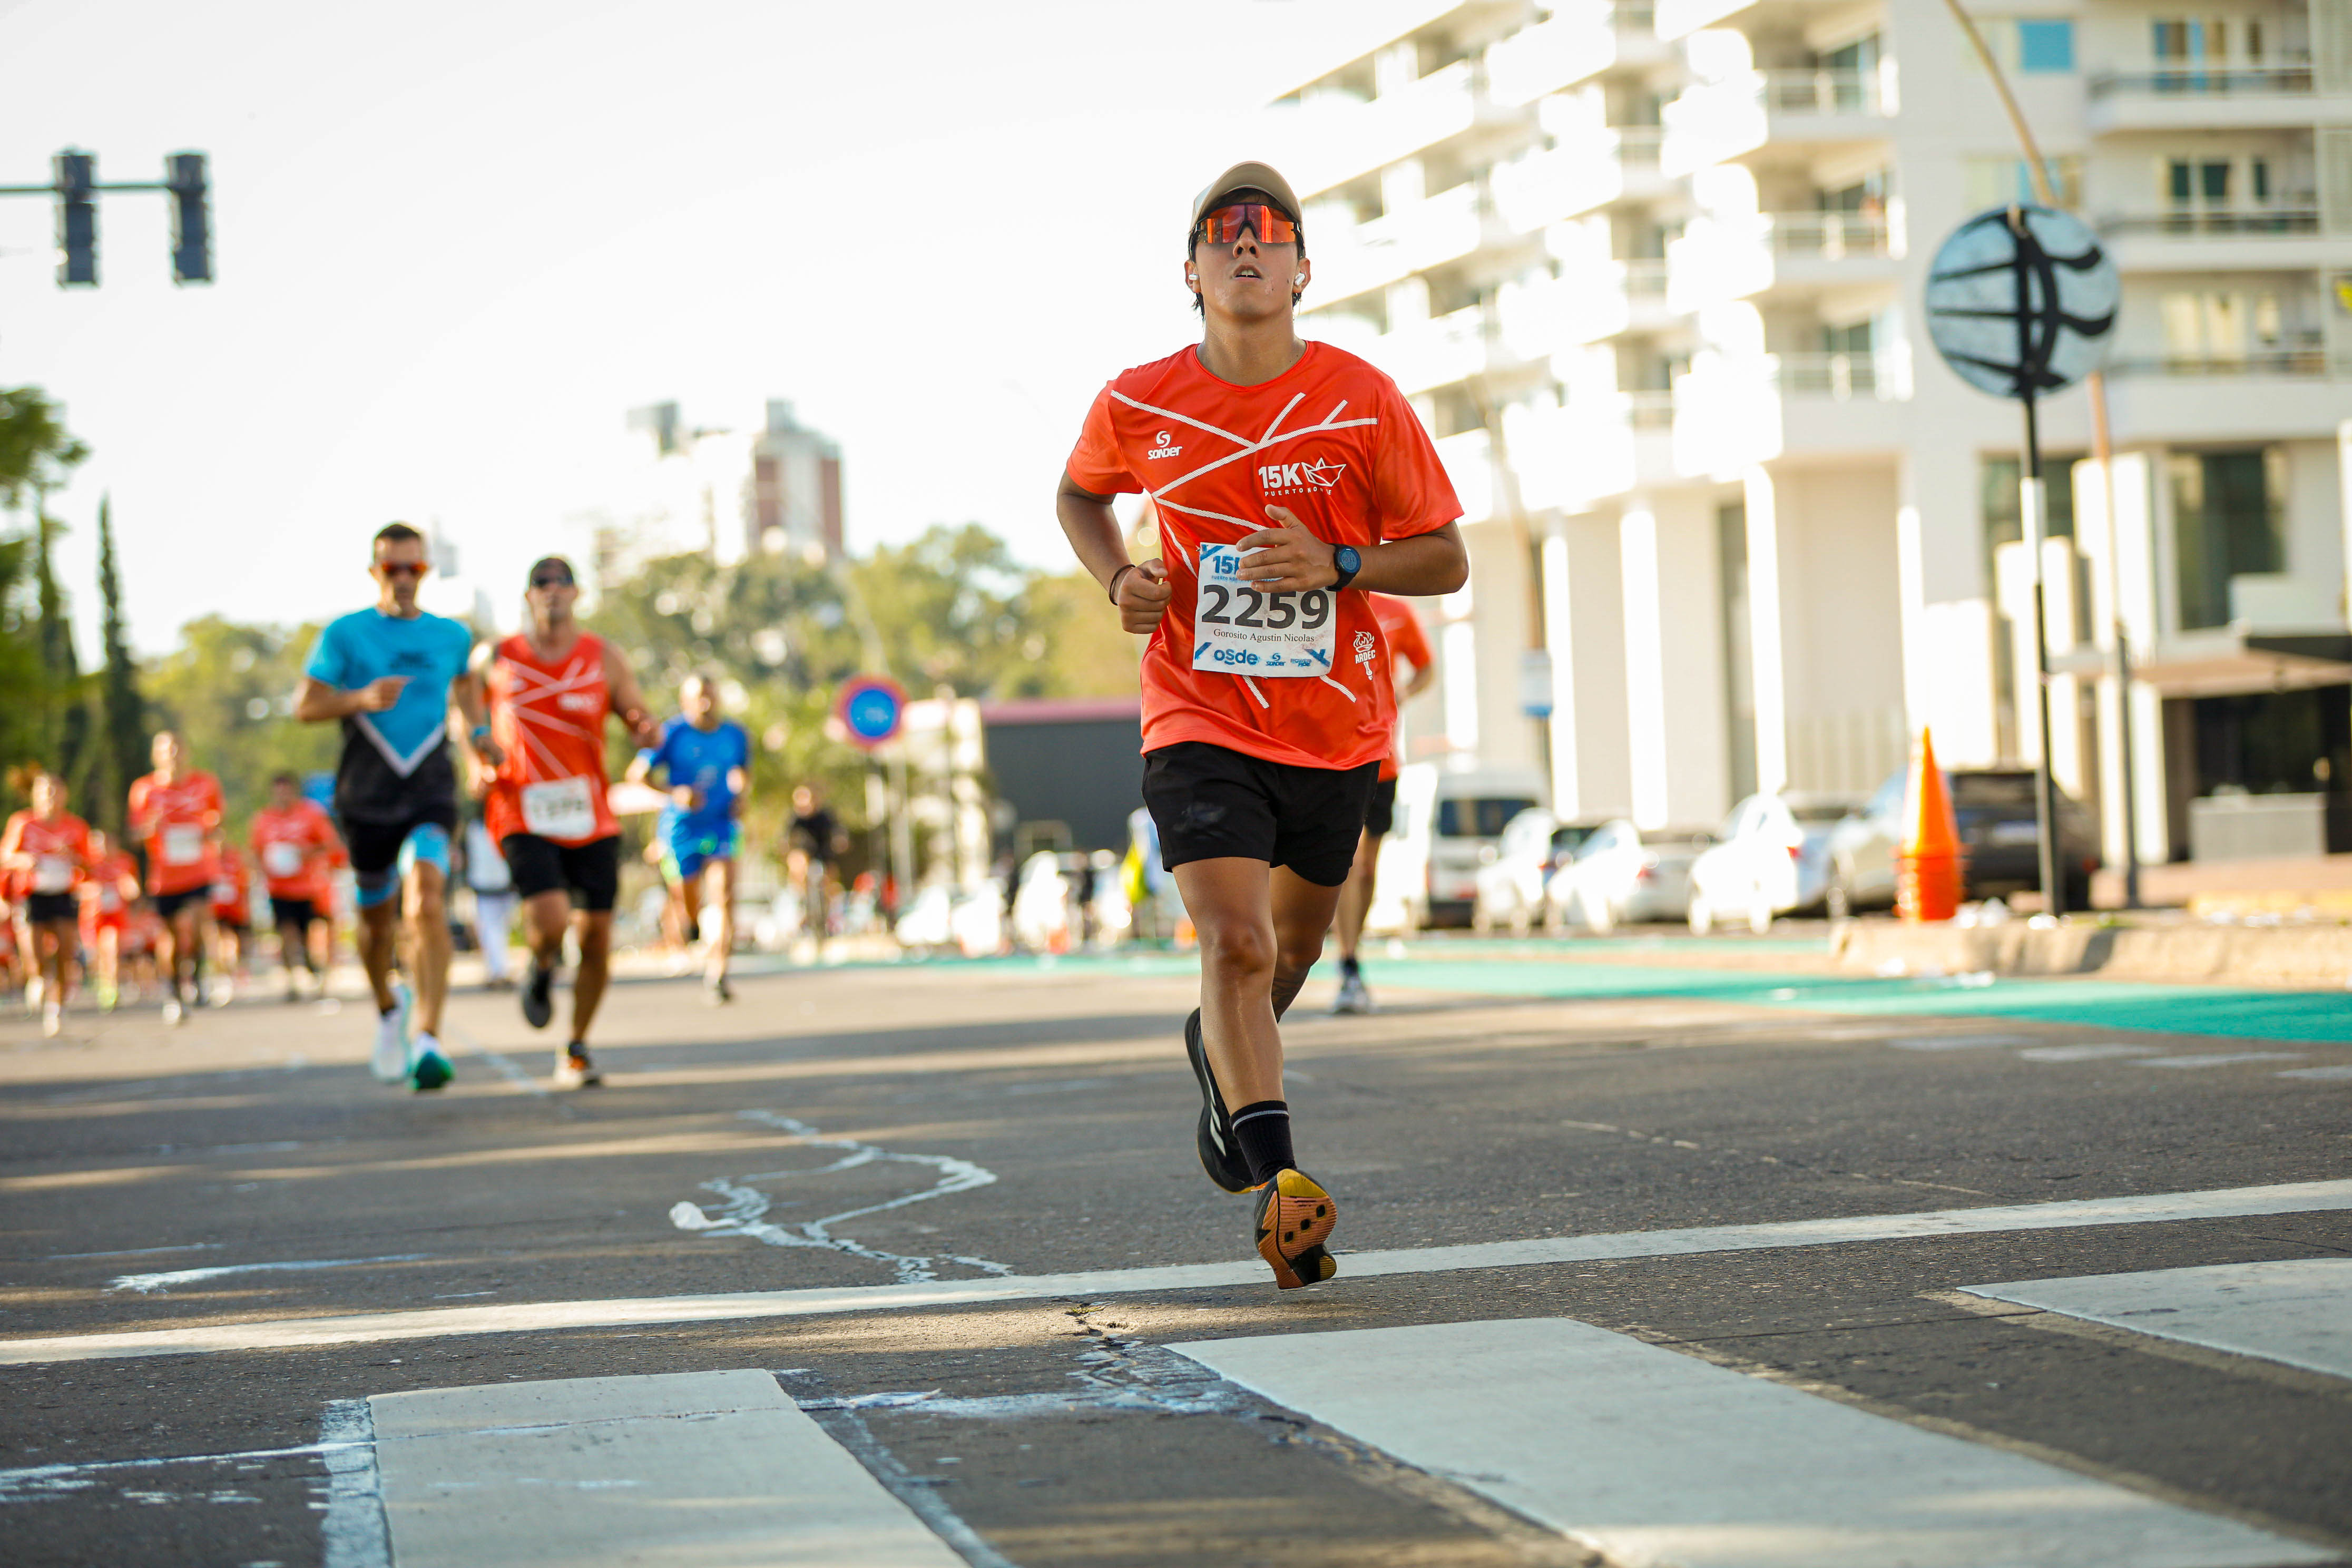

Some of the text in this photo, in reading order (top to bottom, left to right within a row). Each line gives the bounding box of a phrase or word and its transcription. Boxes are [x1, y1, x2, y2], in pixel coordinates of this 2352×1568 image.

[1258, 462, 1303, 488] 15K
[1265, 487, 1304, 496] PUERTO
[1201, 584, 1329, 629] 2259
[1213, 629, 1315, 643] Gorosito Agustin Nicolas
[1214, 649, 1258, 665] osde
[1355, 649, 1376, 664] ARDEC
